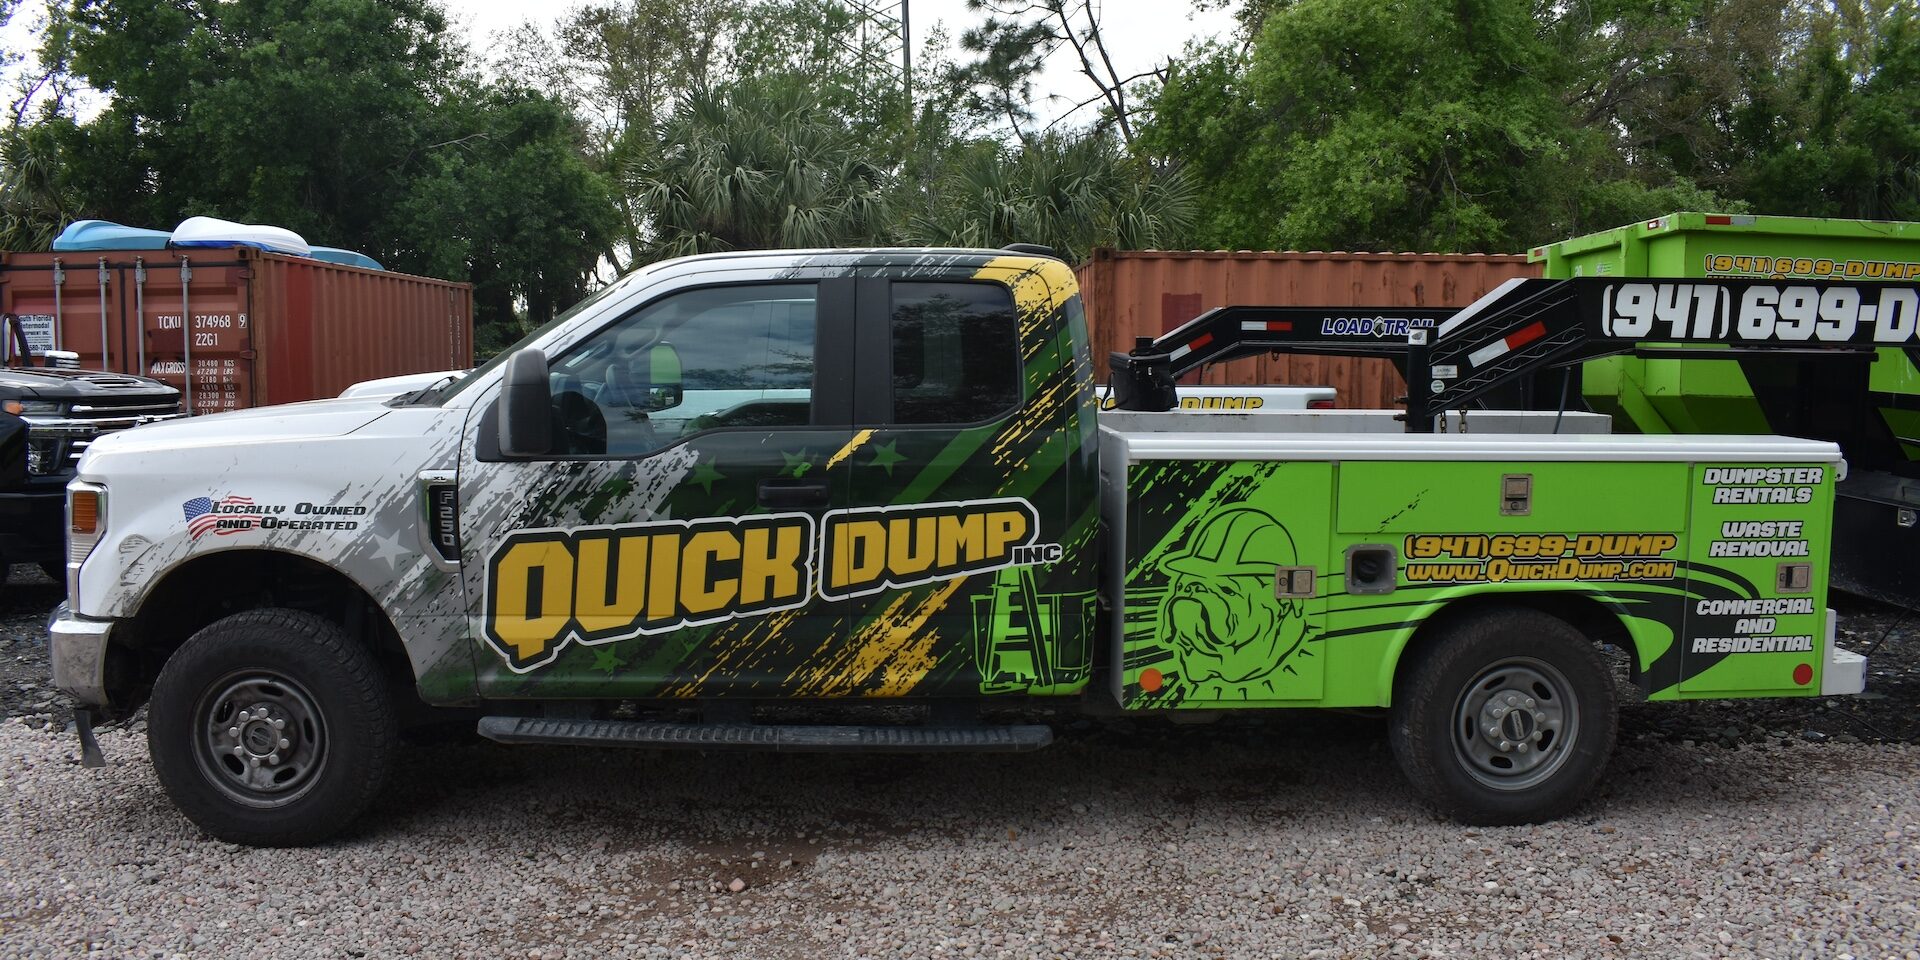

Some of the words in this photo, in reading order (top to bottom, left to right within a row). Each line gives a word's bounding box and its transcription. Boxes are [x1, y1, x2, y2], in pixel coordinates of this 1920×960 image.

[158, 315, 182, 329] TCKU
[194, 315, 231, 329] 374968
[238, 314, 247, 328] 9
[1321, 318, 1374, 335] LOAD
[195, 333, 219, 346] 22G1
[223, 400, 235, 408] LBS
[1179, 397, 1264, 410] DUMP
[1703, 467, 1824, 485] DUMPSTER
[1712, 487, 1813, 504] RENTALS
[1721, 521, 1804, 538] WASTE
[1013, 545, 1062, 565] INC
[1708, 540, 1809, 558] REMOVAL
[492, 522, 805, 662] QUICK
[829, 509, 1029, 590] DUMP
[1696, 598, 1814, 616] COMMERCIAL
[1733, 617, 1777, 634] AND
[1691, 635, 1814, 654] RESIDENTIAL
